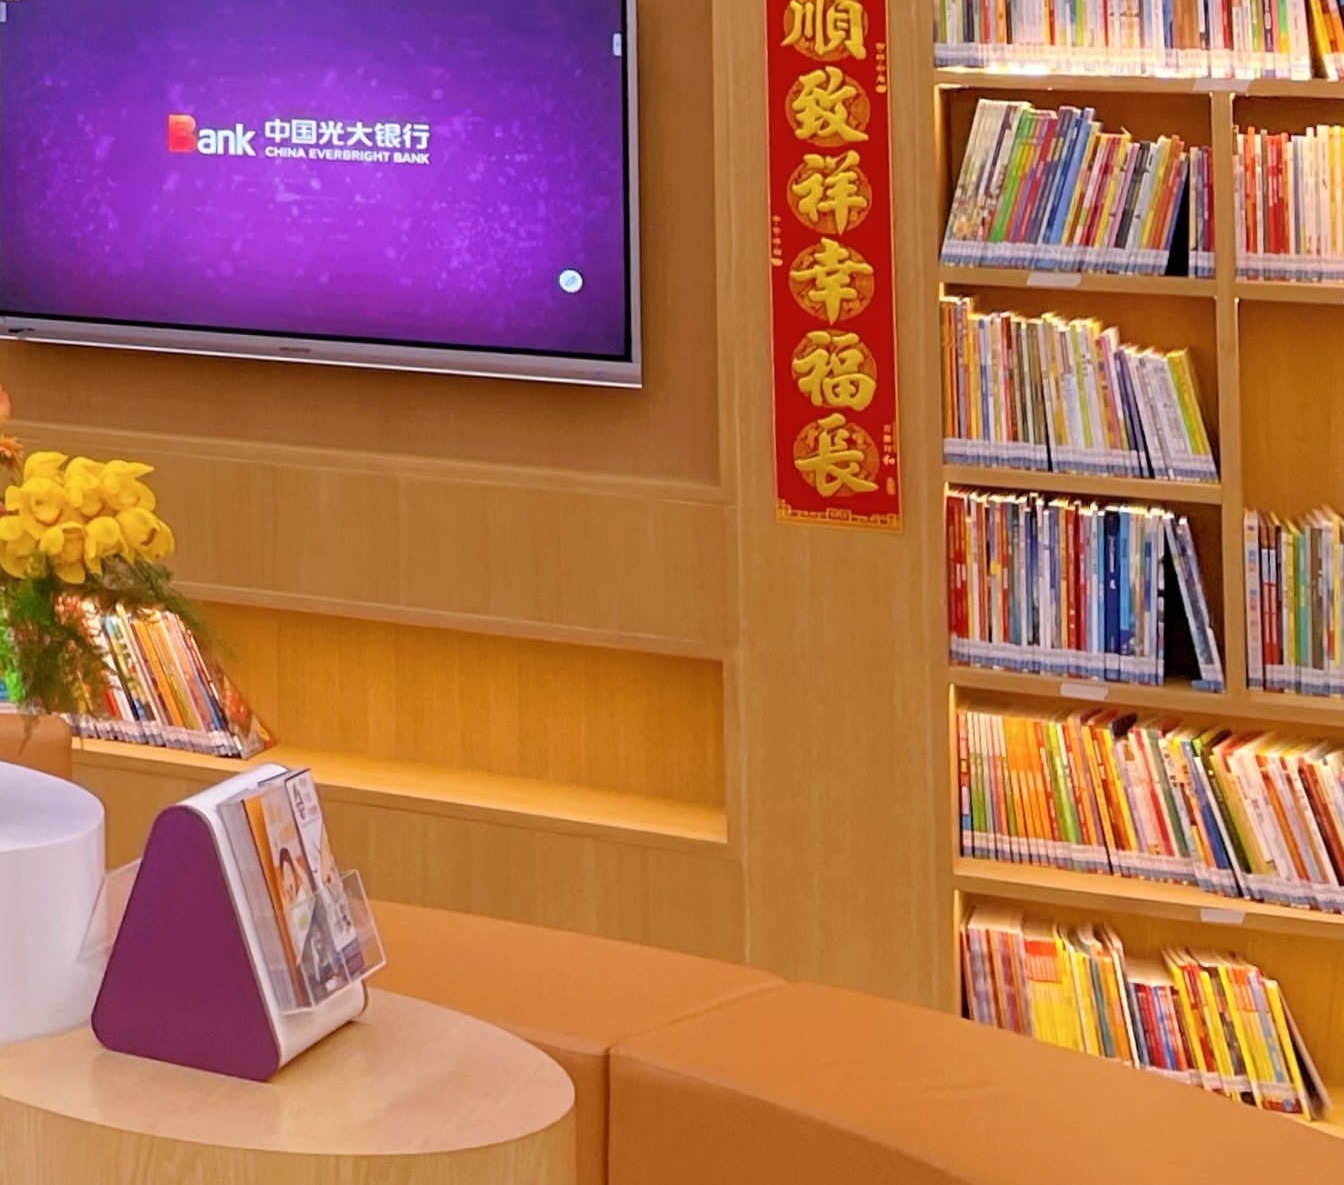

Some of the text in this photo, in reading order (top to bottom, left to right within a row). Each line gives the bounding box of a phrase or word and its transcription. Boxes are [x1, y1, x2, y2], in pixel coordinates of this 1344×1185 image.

[168, 114, 431, 157] Bank 中国光大银行
[264, 145, 431, 165] CHINA EVERBRIGHT BANK
